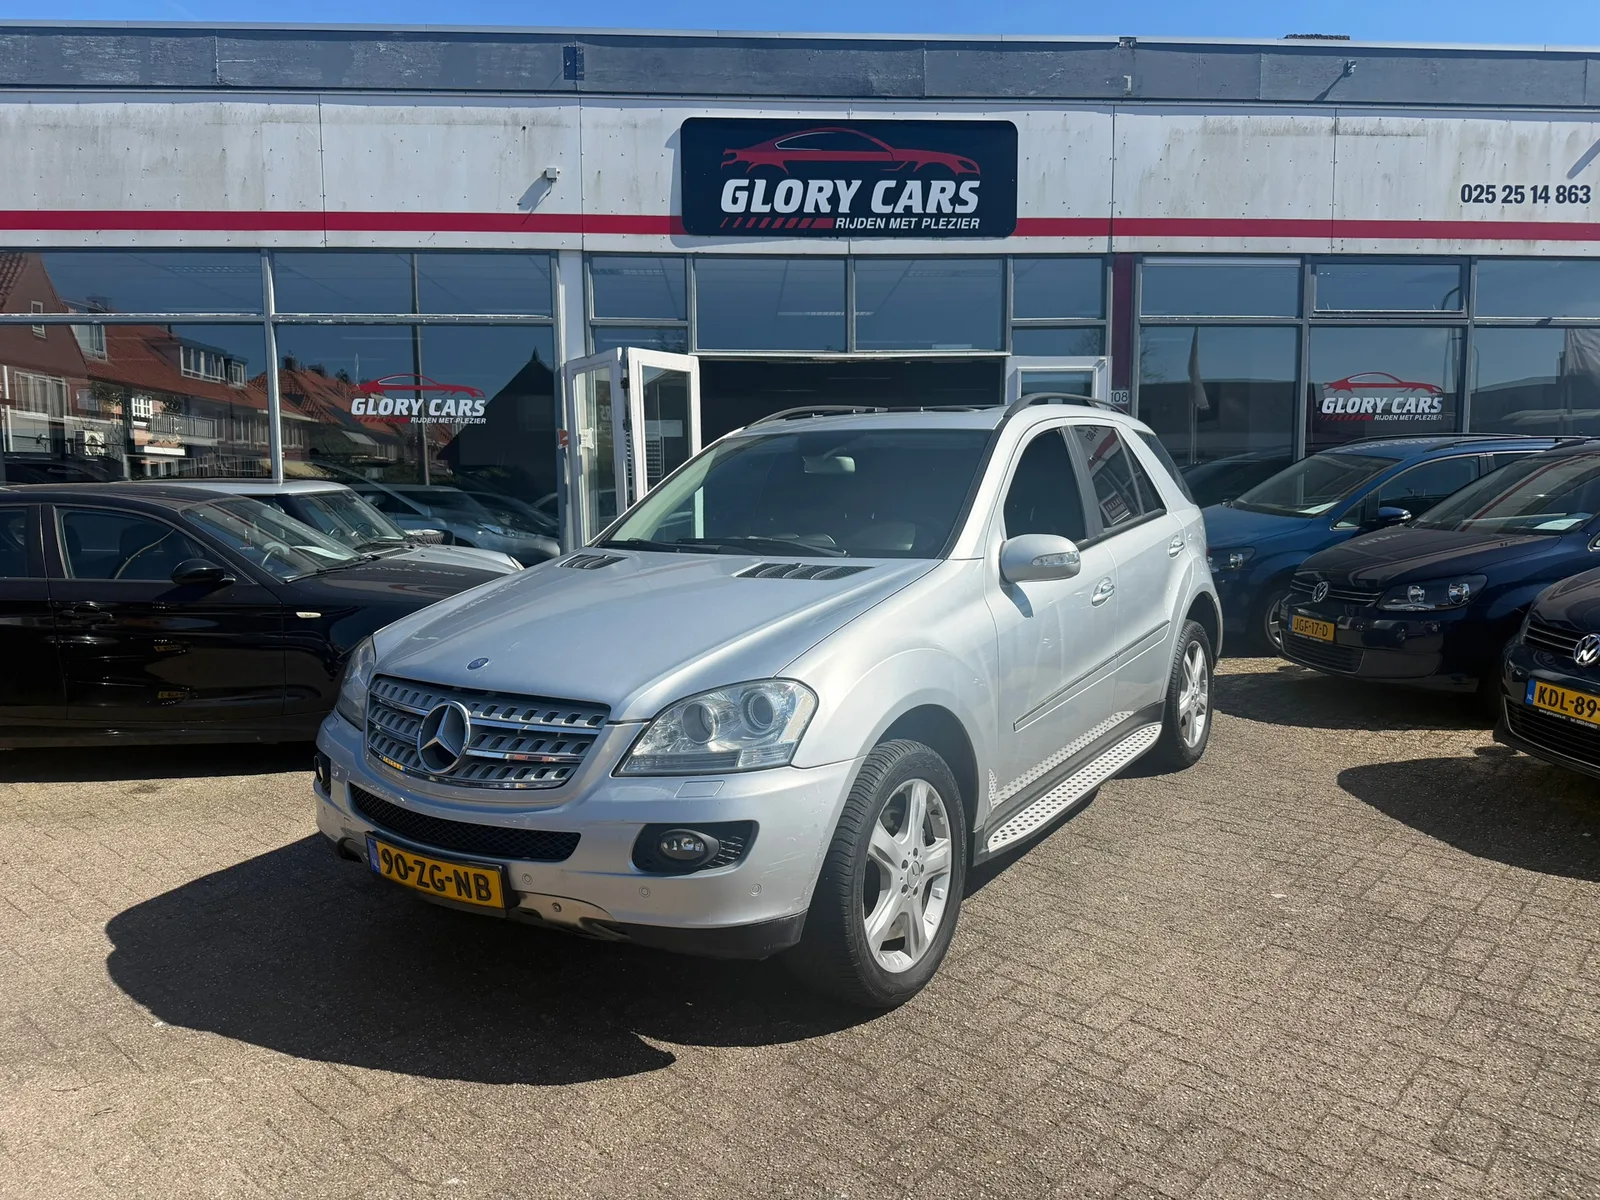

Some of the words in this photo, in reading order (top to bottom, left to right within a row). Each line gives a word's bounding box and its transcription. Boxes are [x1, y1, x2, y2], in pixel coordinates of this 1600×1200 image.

[720, 178, 862, 214] GLORY
[870, 179, 981, 214] CARS
[1460, 183, 1497, 204] 025
[1500, 184, 1525, 204] 25
[1530, 184, 1550, 204] 14
[1555, 184, 1592, 204] 863
[835, 217, 886, 229] RIJDEN
[888, 217, 915, 230] MET
[921, 218, 981, 230] PLEZIER
[1111, 391, 1128, 403] 108
[1321, 397, 1388, 414] GLORY
[1391, 397, 1444, 414] CARS
[351, 398, 424, 416] GLORY
[428, 399, 486, 417] CARS
[455, 417, 487, 425] PLEZIER
[1294, 618, 1329, 637] JGF-17-D
[380, 848, 492, 901] 90-ZG-NB
